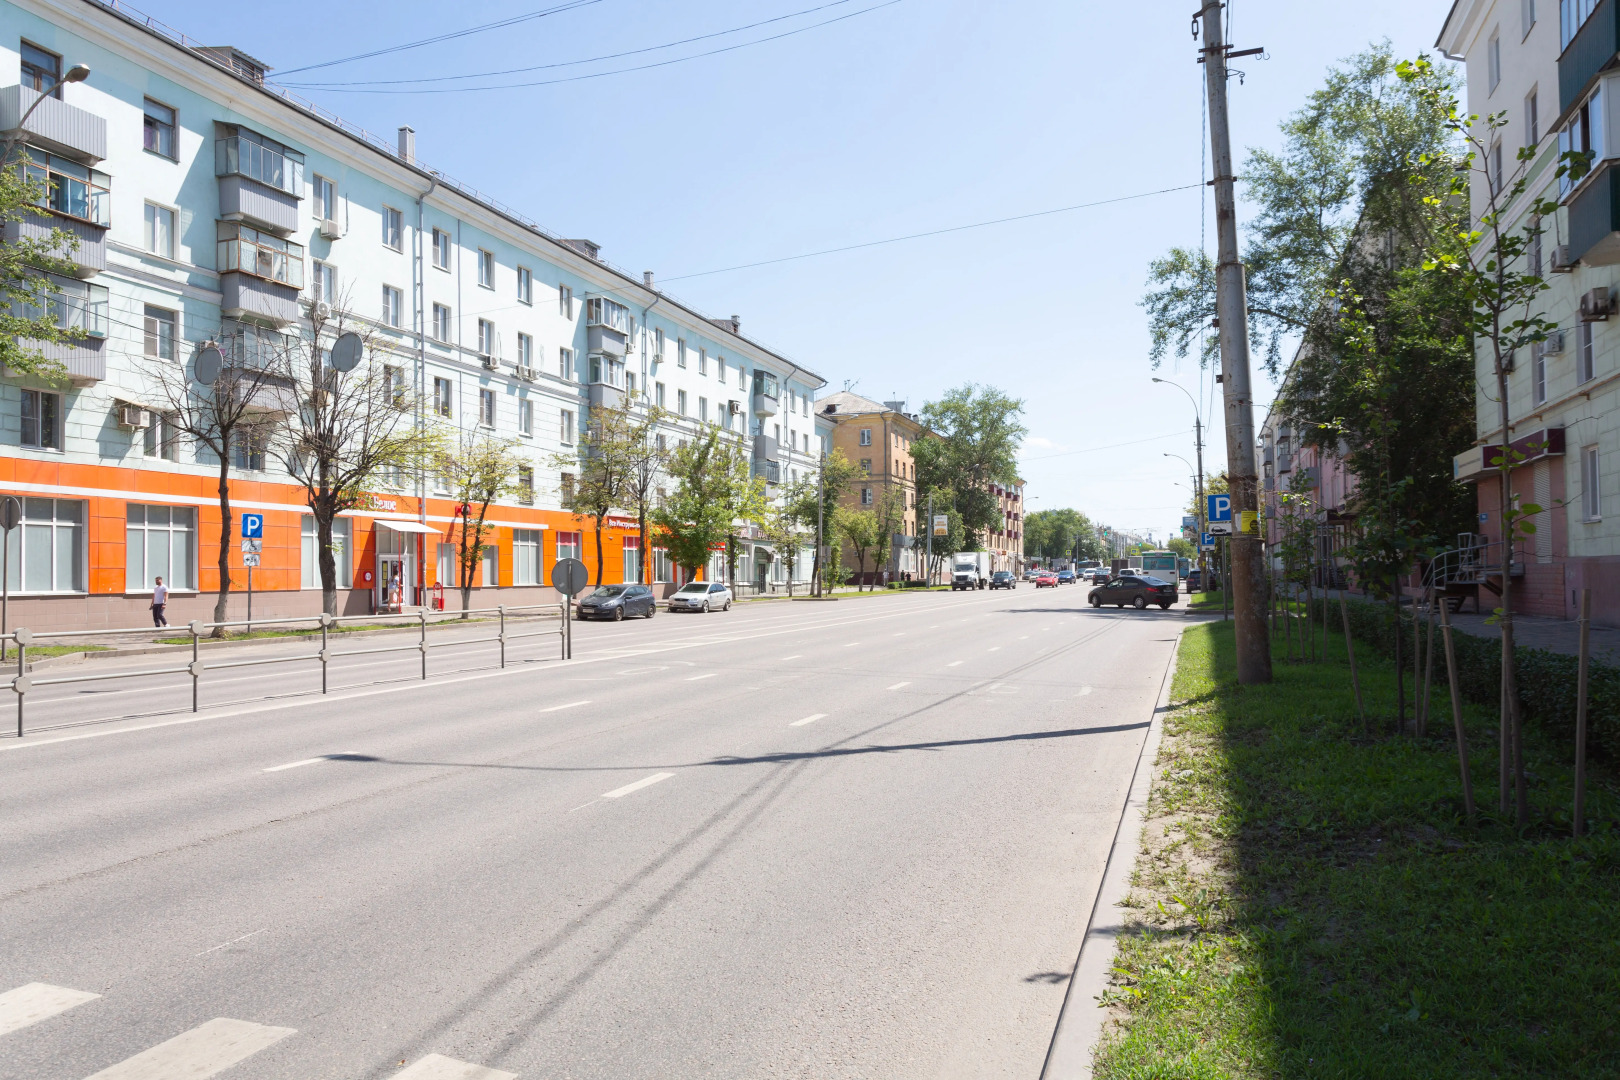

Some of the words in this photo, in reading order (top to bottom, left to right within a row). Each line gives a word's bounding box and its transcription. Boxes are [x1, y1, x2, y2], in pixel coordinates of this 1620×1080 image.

[1215, 497, 1231, 518] P
[247, 516, 260, 536] P
[1204, 533, 1213, 544] P
